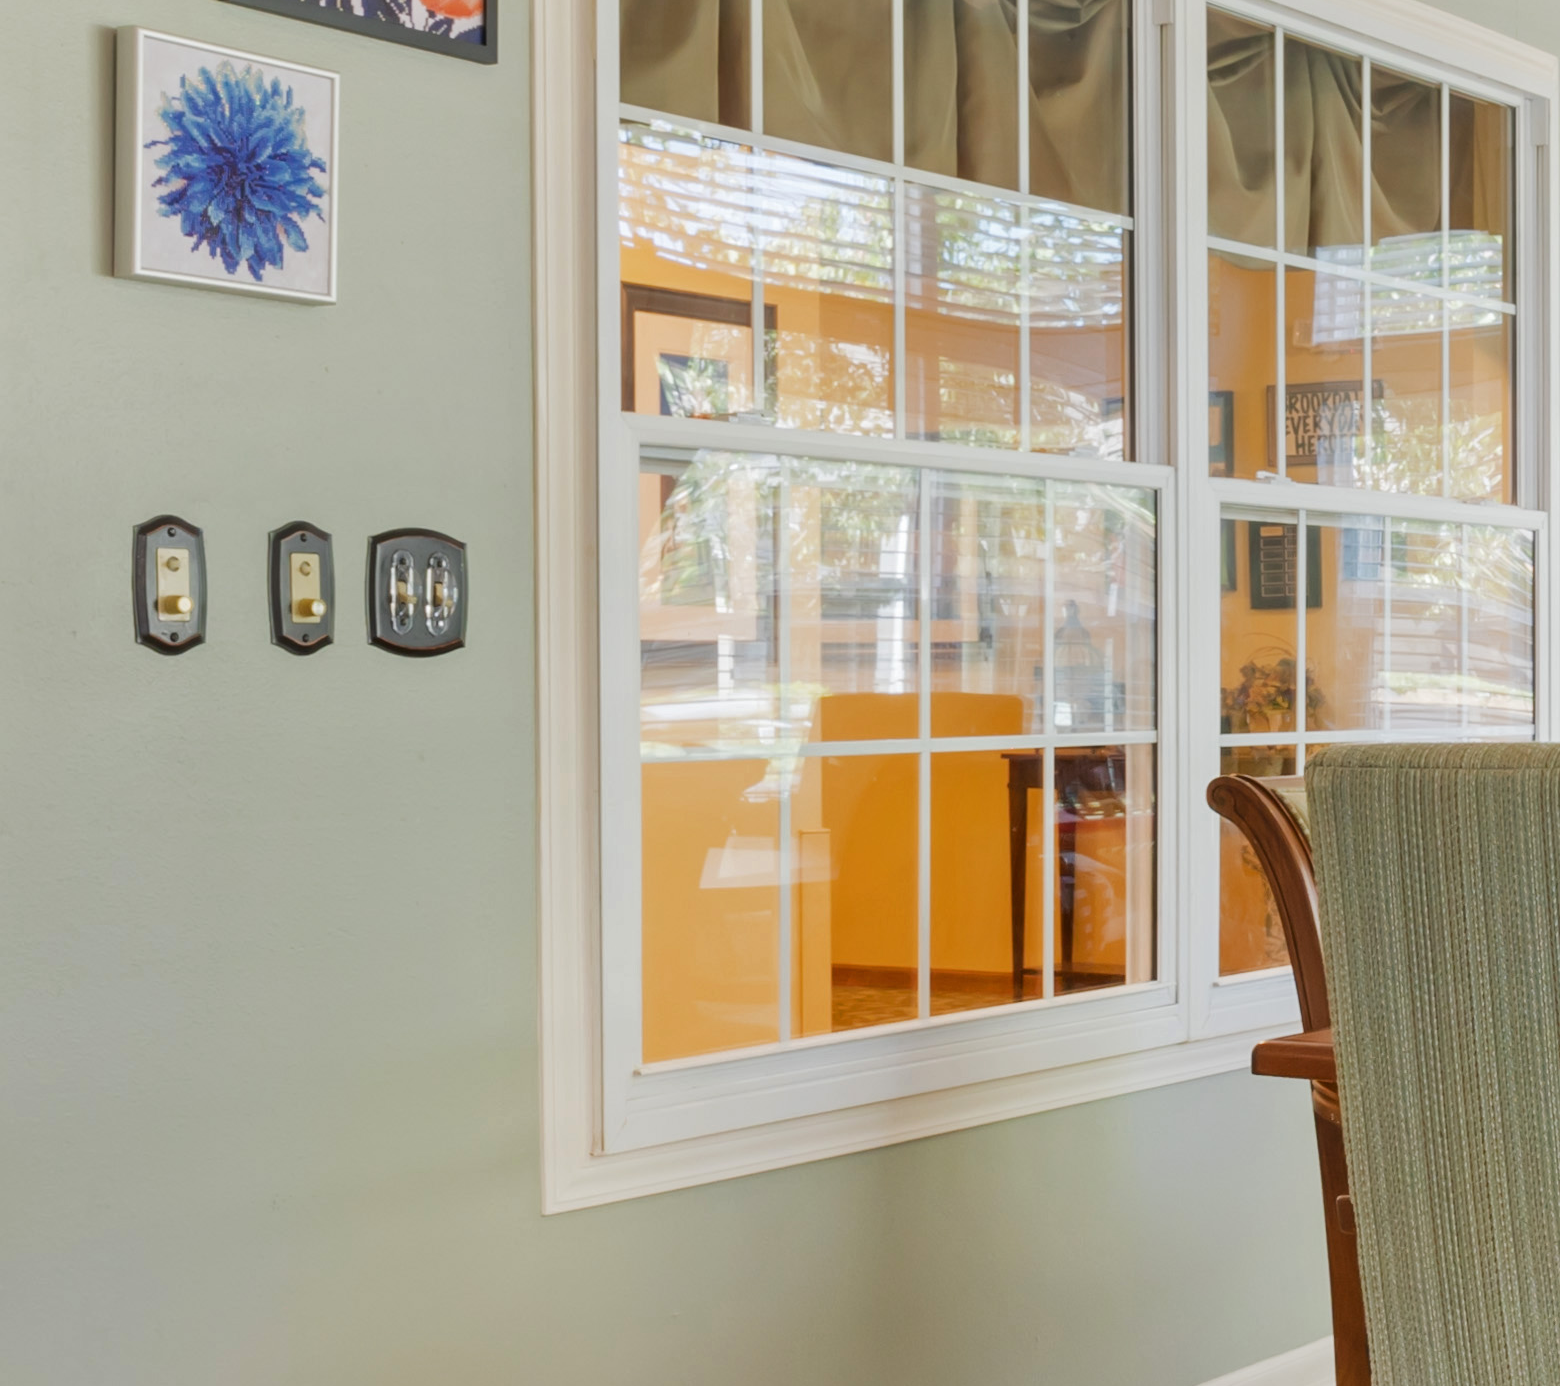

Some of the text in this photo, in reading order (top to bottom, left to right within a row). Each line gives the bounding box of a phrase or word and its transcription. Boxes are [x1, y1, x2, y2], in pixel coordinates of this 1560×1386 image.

[1285, 391, 1362, 414] ROOKDA
[1285, 411, 1364, 435] EVERYDA
[1295, 434, 1356, 455] HEROE
